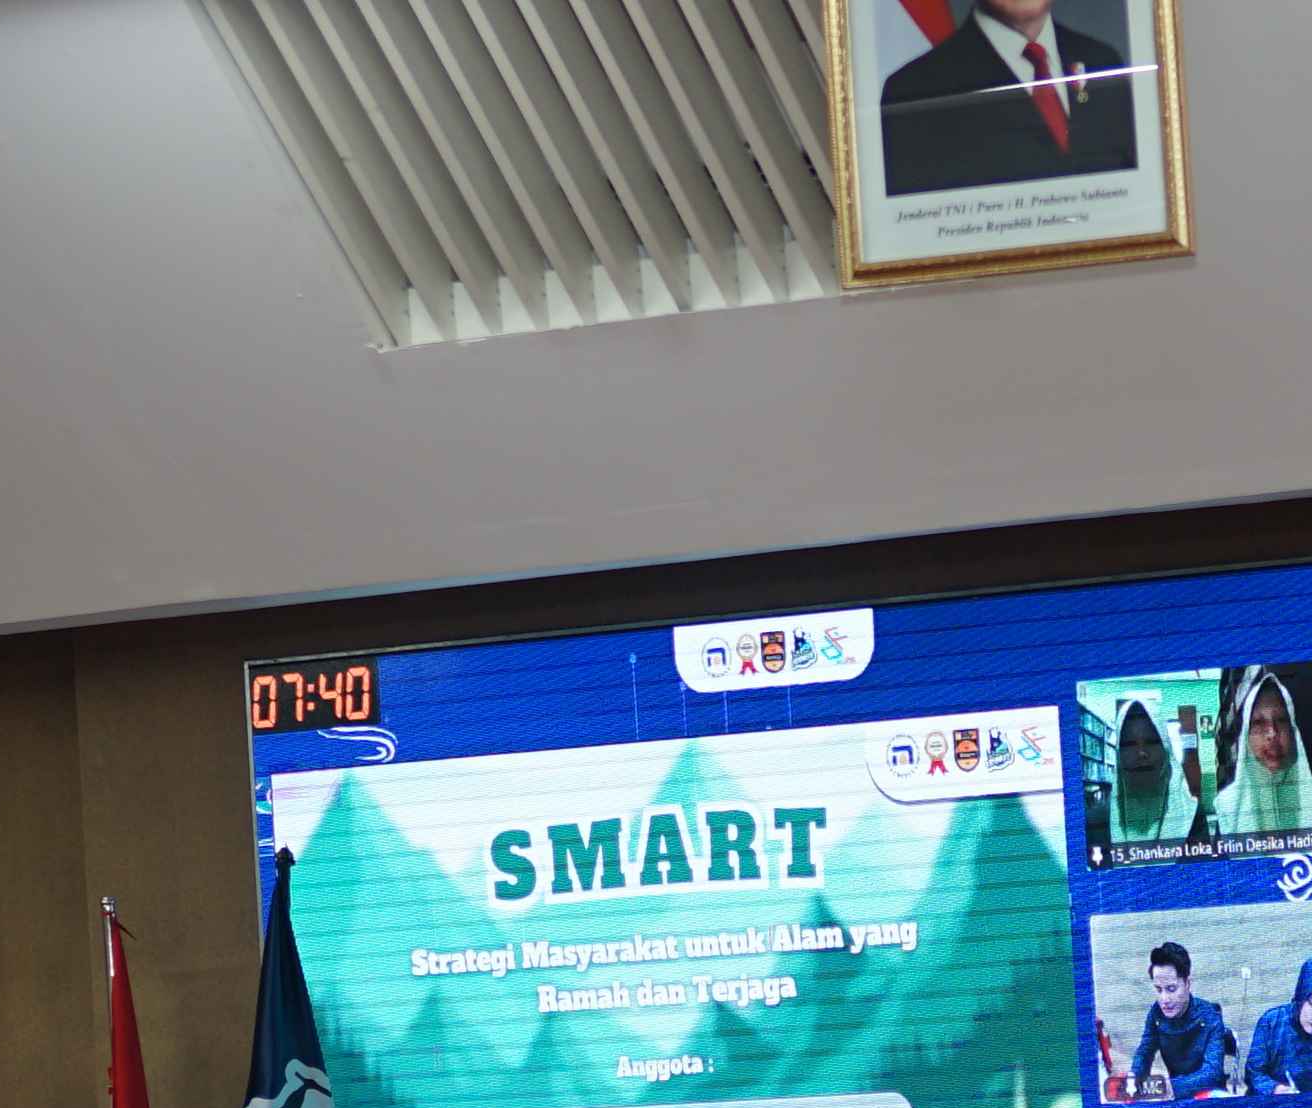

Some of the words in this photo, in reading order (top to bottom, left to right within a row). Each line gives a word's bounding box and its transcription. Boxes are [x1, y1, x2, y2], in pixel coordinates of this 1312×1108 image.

[946, 203, 967, 218] TNI
[1037, 212, 1089, 228] Indoia
[253, 667, 370, 728] 07:40
[491, 806, 827, 900] SMART
[1246, 835, 1286, 852] Desika
[411, 944, 516, 977] Strategi
[521, 934, 678, 973] Masyarakat
[683, 927, 765, 957] untuk
[771, 922, 844, 951] Alam
[848, 921, 917, 954] yang
[538, 982, 631, 1013] Ramah
[637, 978, 686, 1006] dan
[692, 974, 797, 1007] Terjaga
